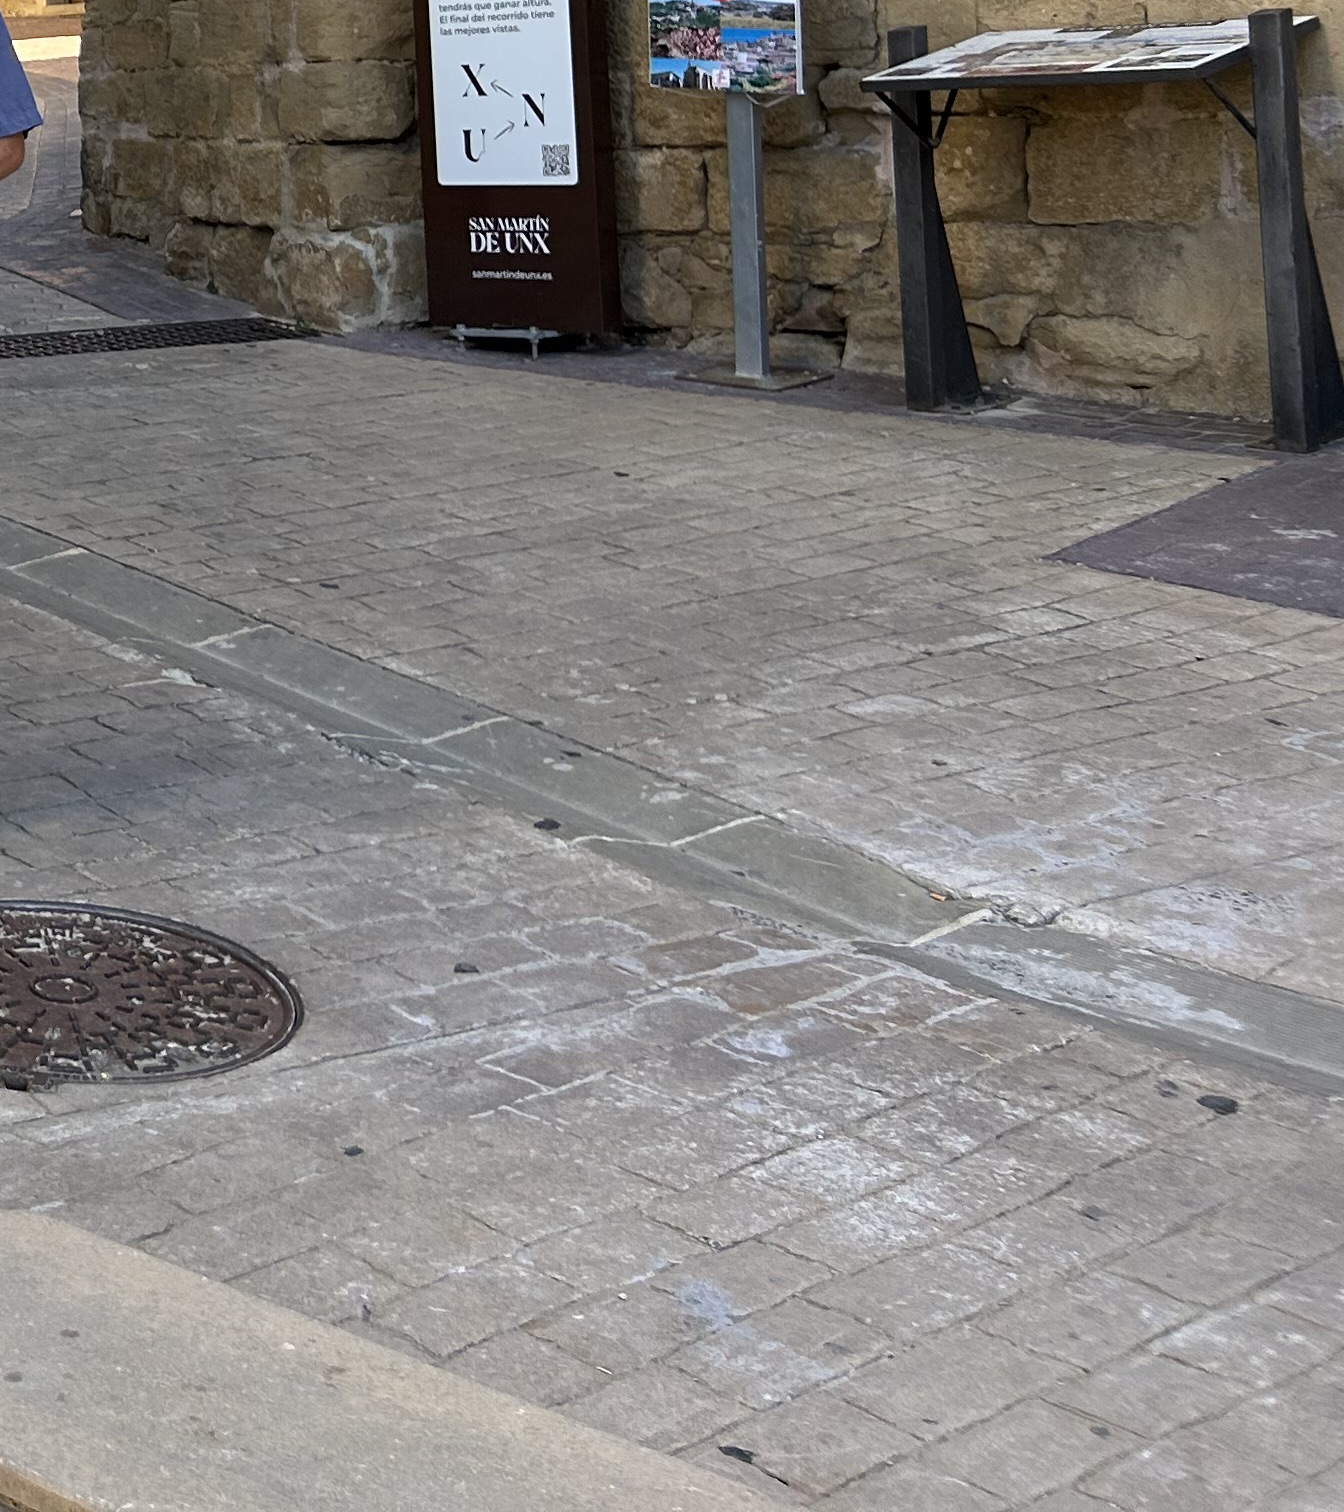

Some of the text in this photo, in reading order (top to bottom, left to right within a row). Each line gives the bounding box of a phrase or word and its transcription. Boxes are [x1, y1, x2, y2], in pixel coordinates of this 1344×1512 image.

[474, 2, 492, 11] que
[494, 0, 520, 10] ganar
[439, 10, 555, 24] El final del recorrido tiene
[440, 27, 452, 36] las
[454, 25, 490, 36] mejores
[461, 63, 488, 97] X
[522, 93, 546, 127] N
[462, 128, 486, 163] U
[468, 214, 550, 231] SAN MARTÍN
[470, 232, 551, 254] DE UNX
